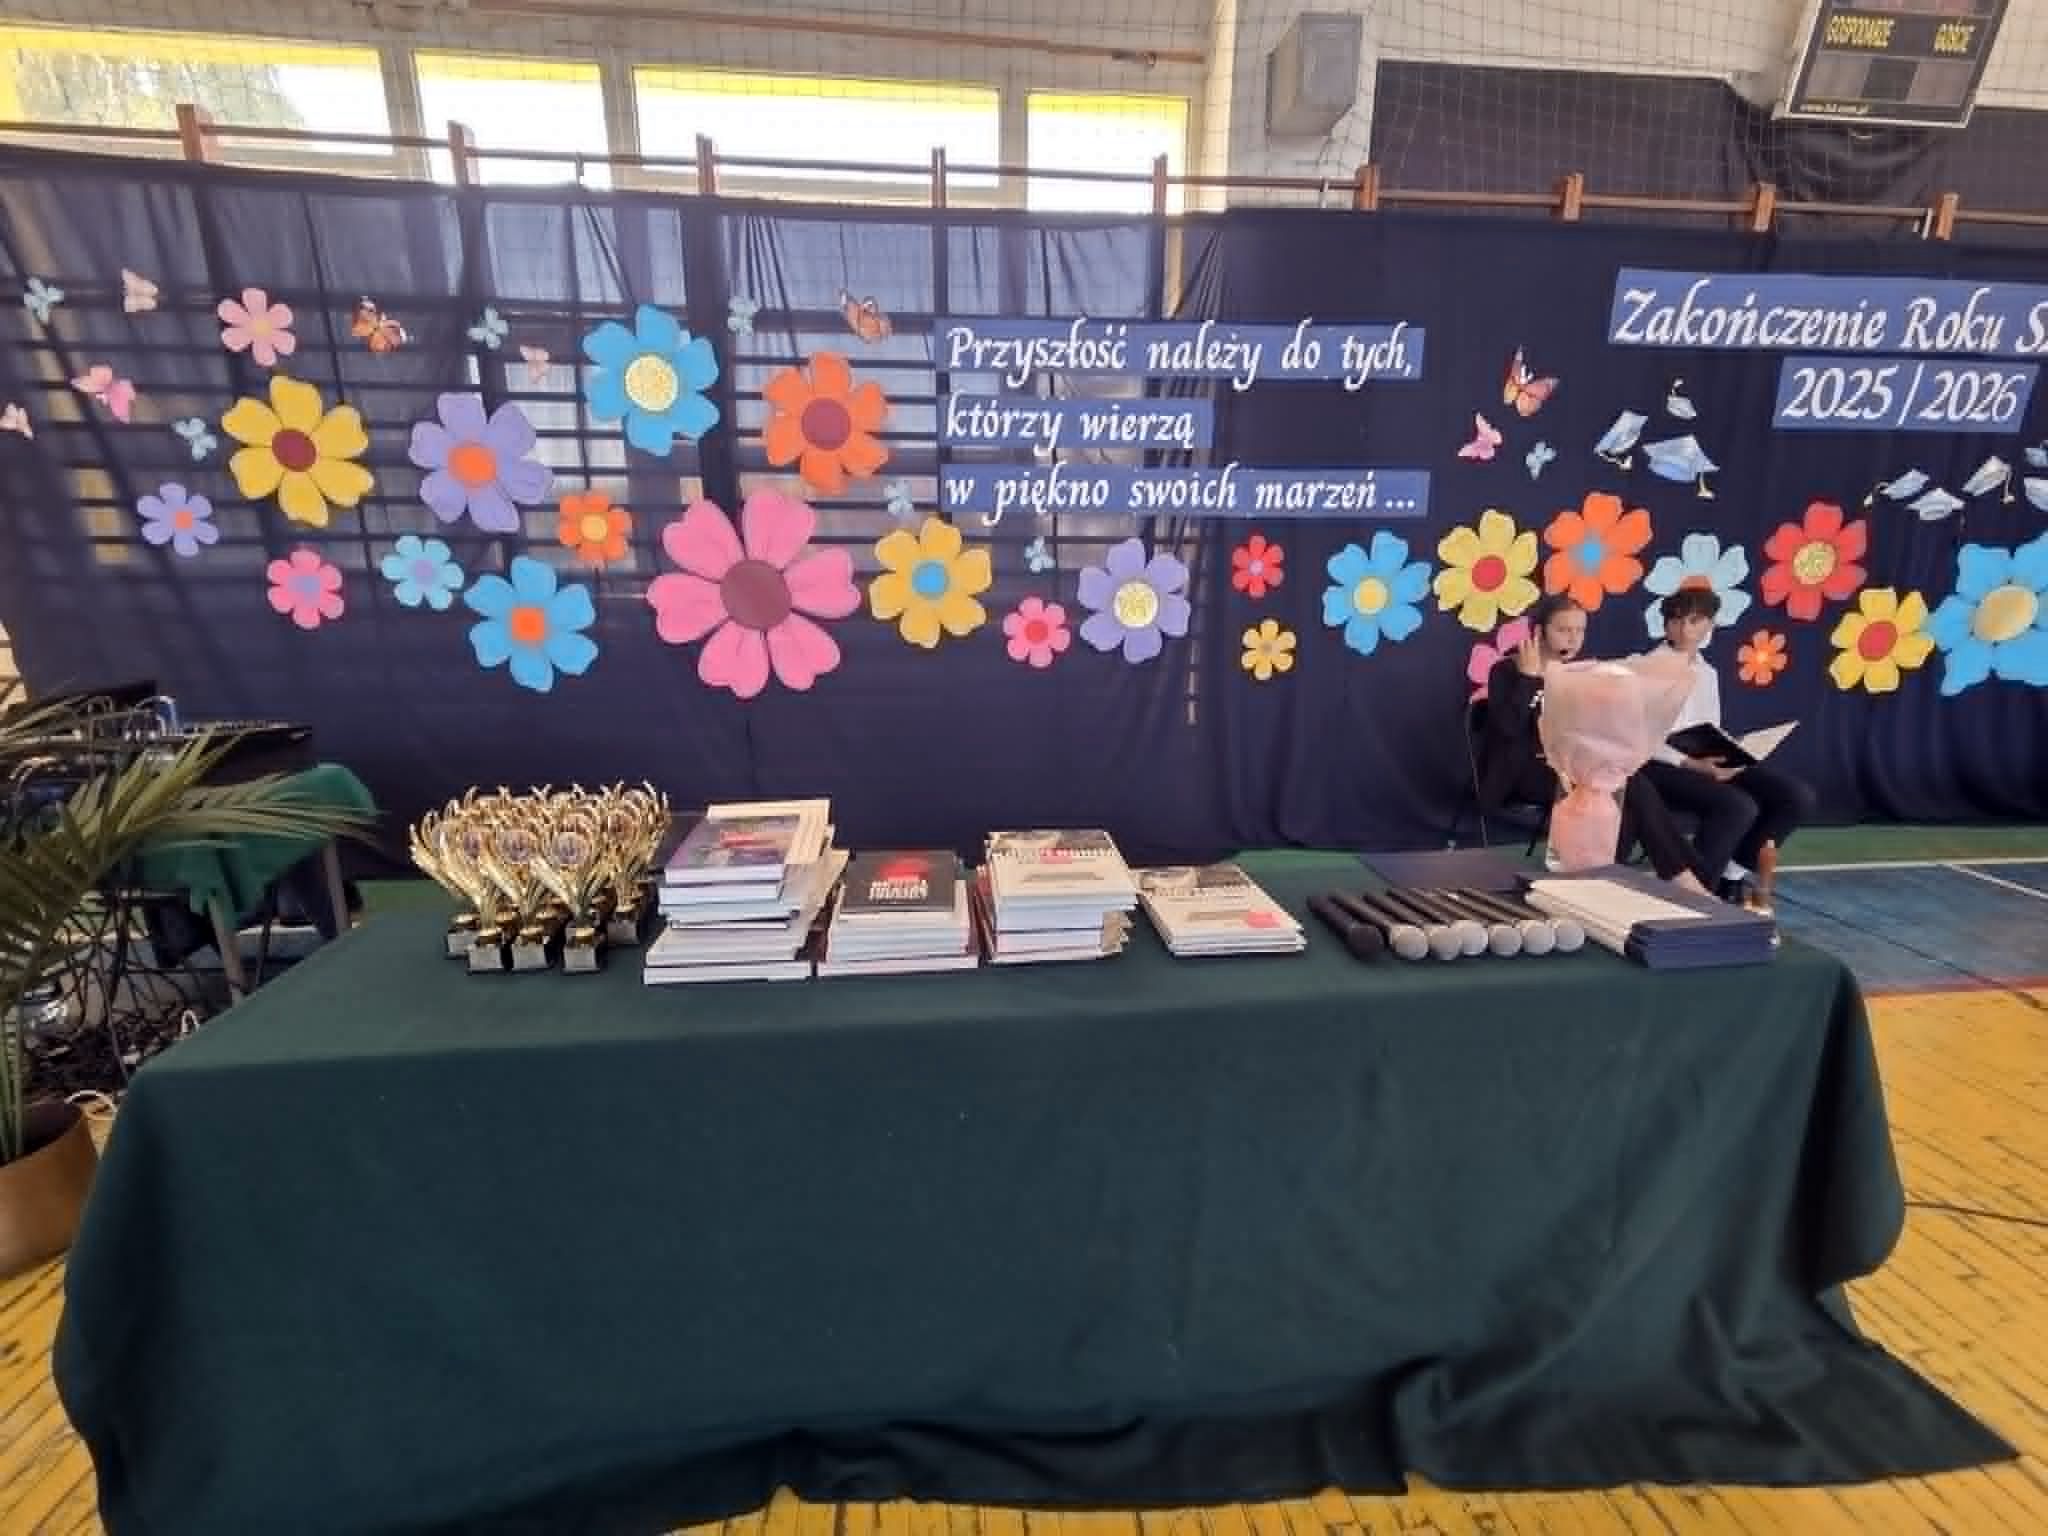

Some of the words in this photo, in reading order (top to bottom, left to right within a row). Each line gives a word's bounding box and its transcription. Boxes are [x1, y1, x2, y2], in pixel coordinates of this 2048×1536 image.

[1614, 278, 1887, 346] Zakończenie
[1901, 287, 2006, 352] Roku
[2014, 300, 2048, 353] S
[946, 317, 1128, 386] Przyszłość
[1148, 321, 1263, 391] należy
[1281, 318, 1320, 371] do
[1341, 321, 1413, 391] tych,
[946, 391, 1062, 457] którzy
[1080, 405, 1195, 448] wierzą
[946, 476, 974, 505] w
[983, 462, 1110, 526] piękno
[1128, 462, 1239, 509] swoich
